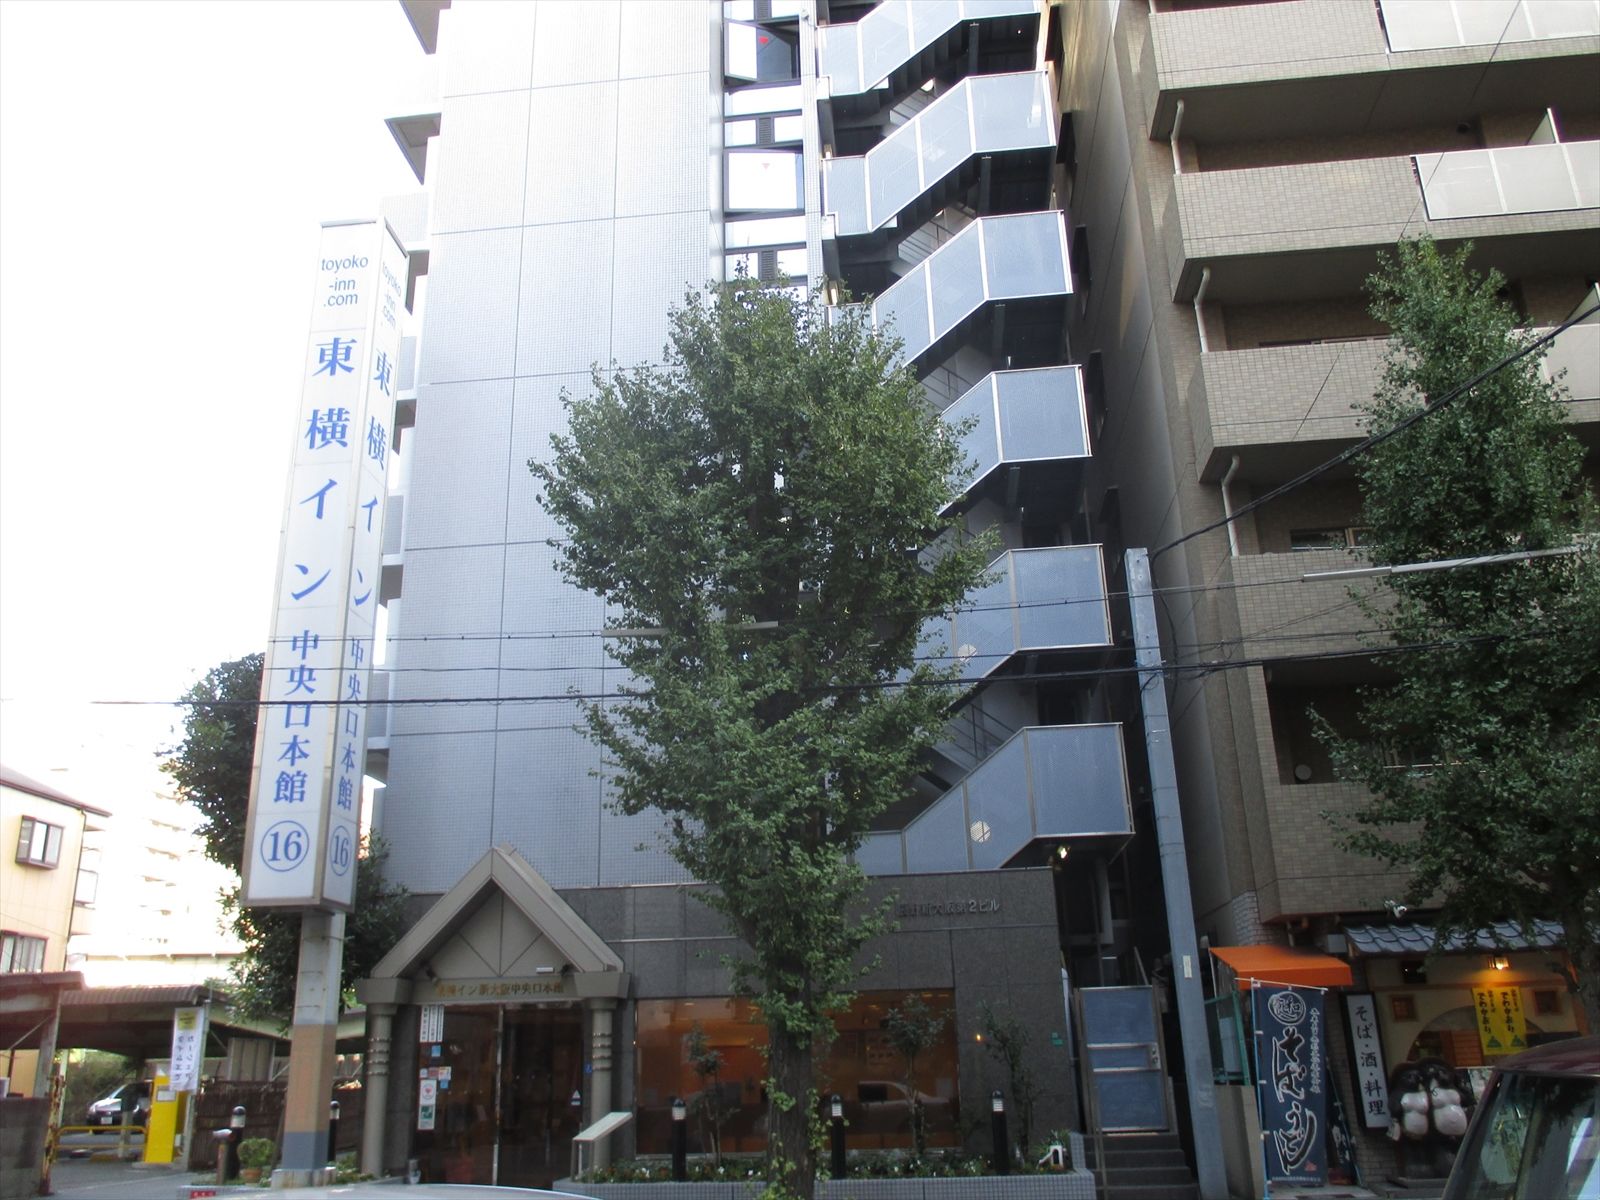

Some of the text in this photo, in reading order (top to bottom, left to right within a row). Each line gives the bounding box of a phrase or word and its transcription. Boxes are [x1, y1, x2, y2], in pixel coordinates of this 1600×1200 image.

[321, 255, 368, 273] toyoko
[328, 276, 356, 292] -inn
[323, 293, 358, 307] .com
[268, 830, 303, 862] 16
[332, 833, 350, 868] 16
